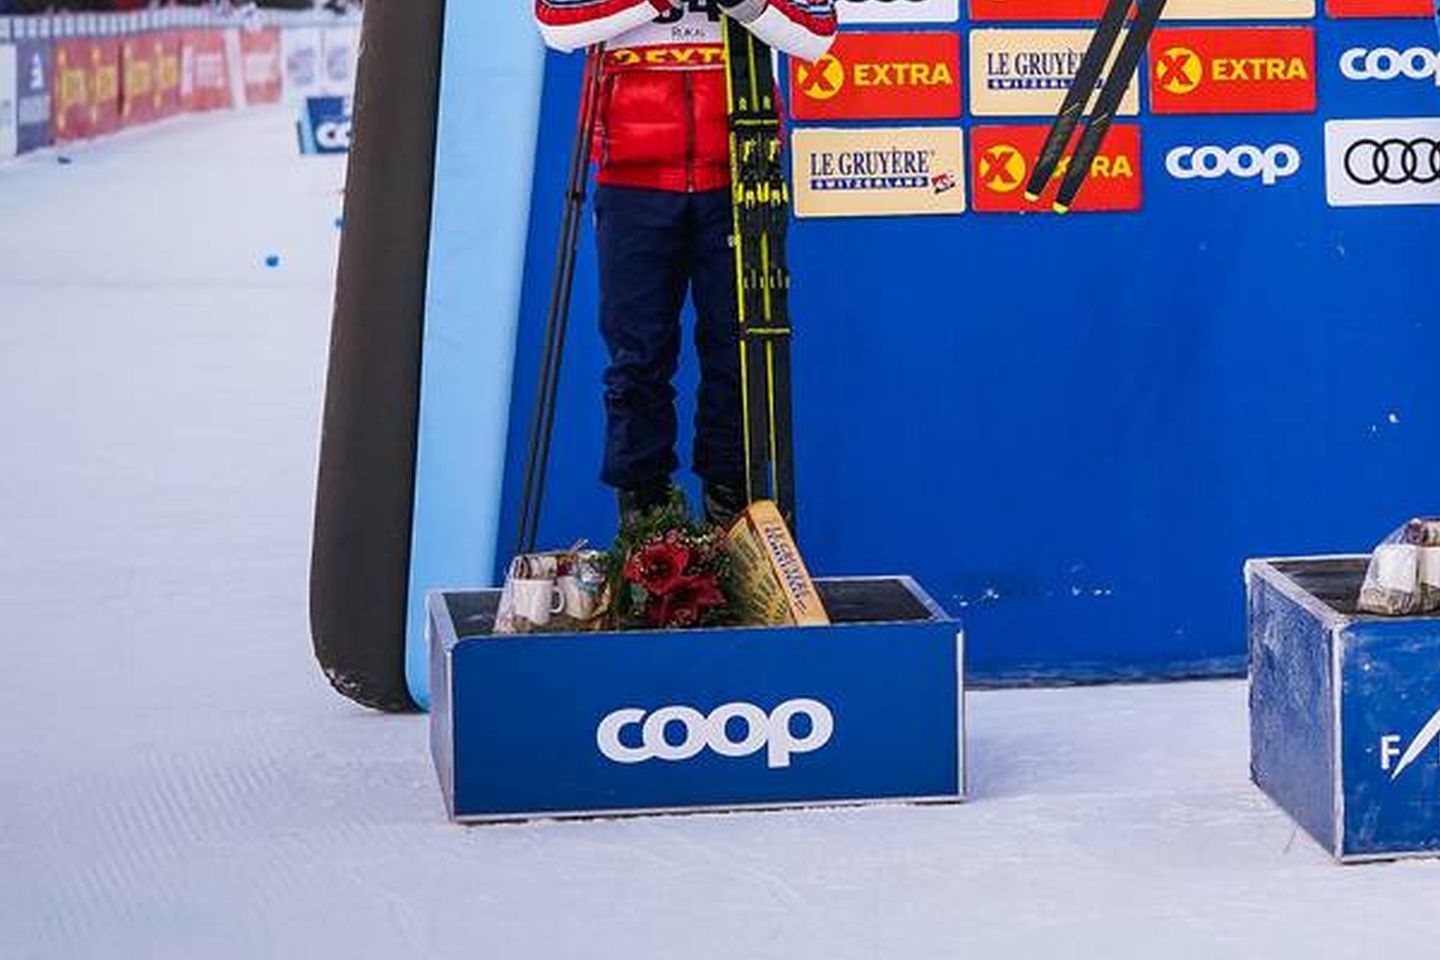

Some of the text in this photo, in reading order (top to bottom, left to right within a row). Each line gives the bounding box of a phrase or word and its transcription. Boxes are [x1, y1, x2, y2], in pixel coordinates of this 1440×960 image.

[854, 63, 952, 86] EXTRA
[988, 48, 1086, 76] LE GRUYÈ
[1212, 58, 1306, 80] EXTRA
[810, 147, 928, 176] LE GRUYÈRE
[1165, 144, 1300, 184] coop
[811, 177, 928, 189] SWITZERLAND
[597, 698, 833, 768] coop
